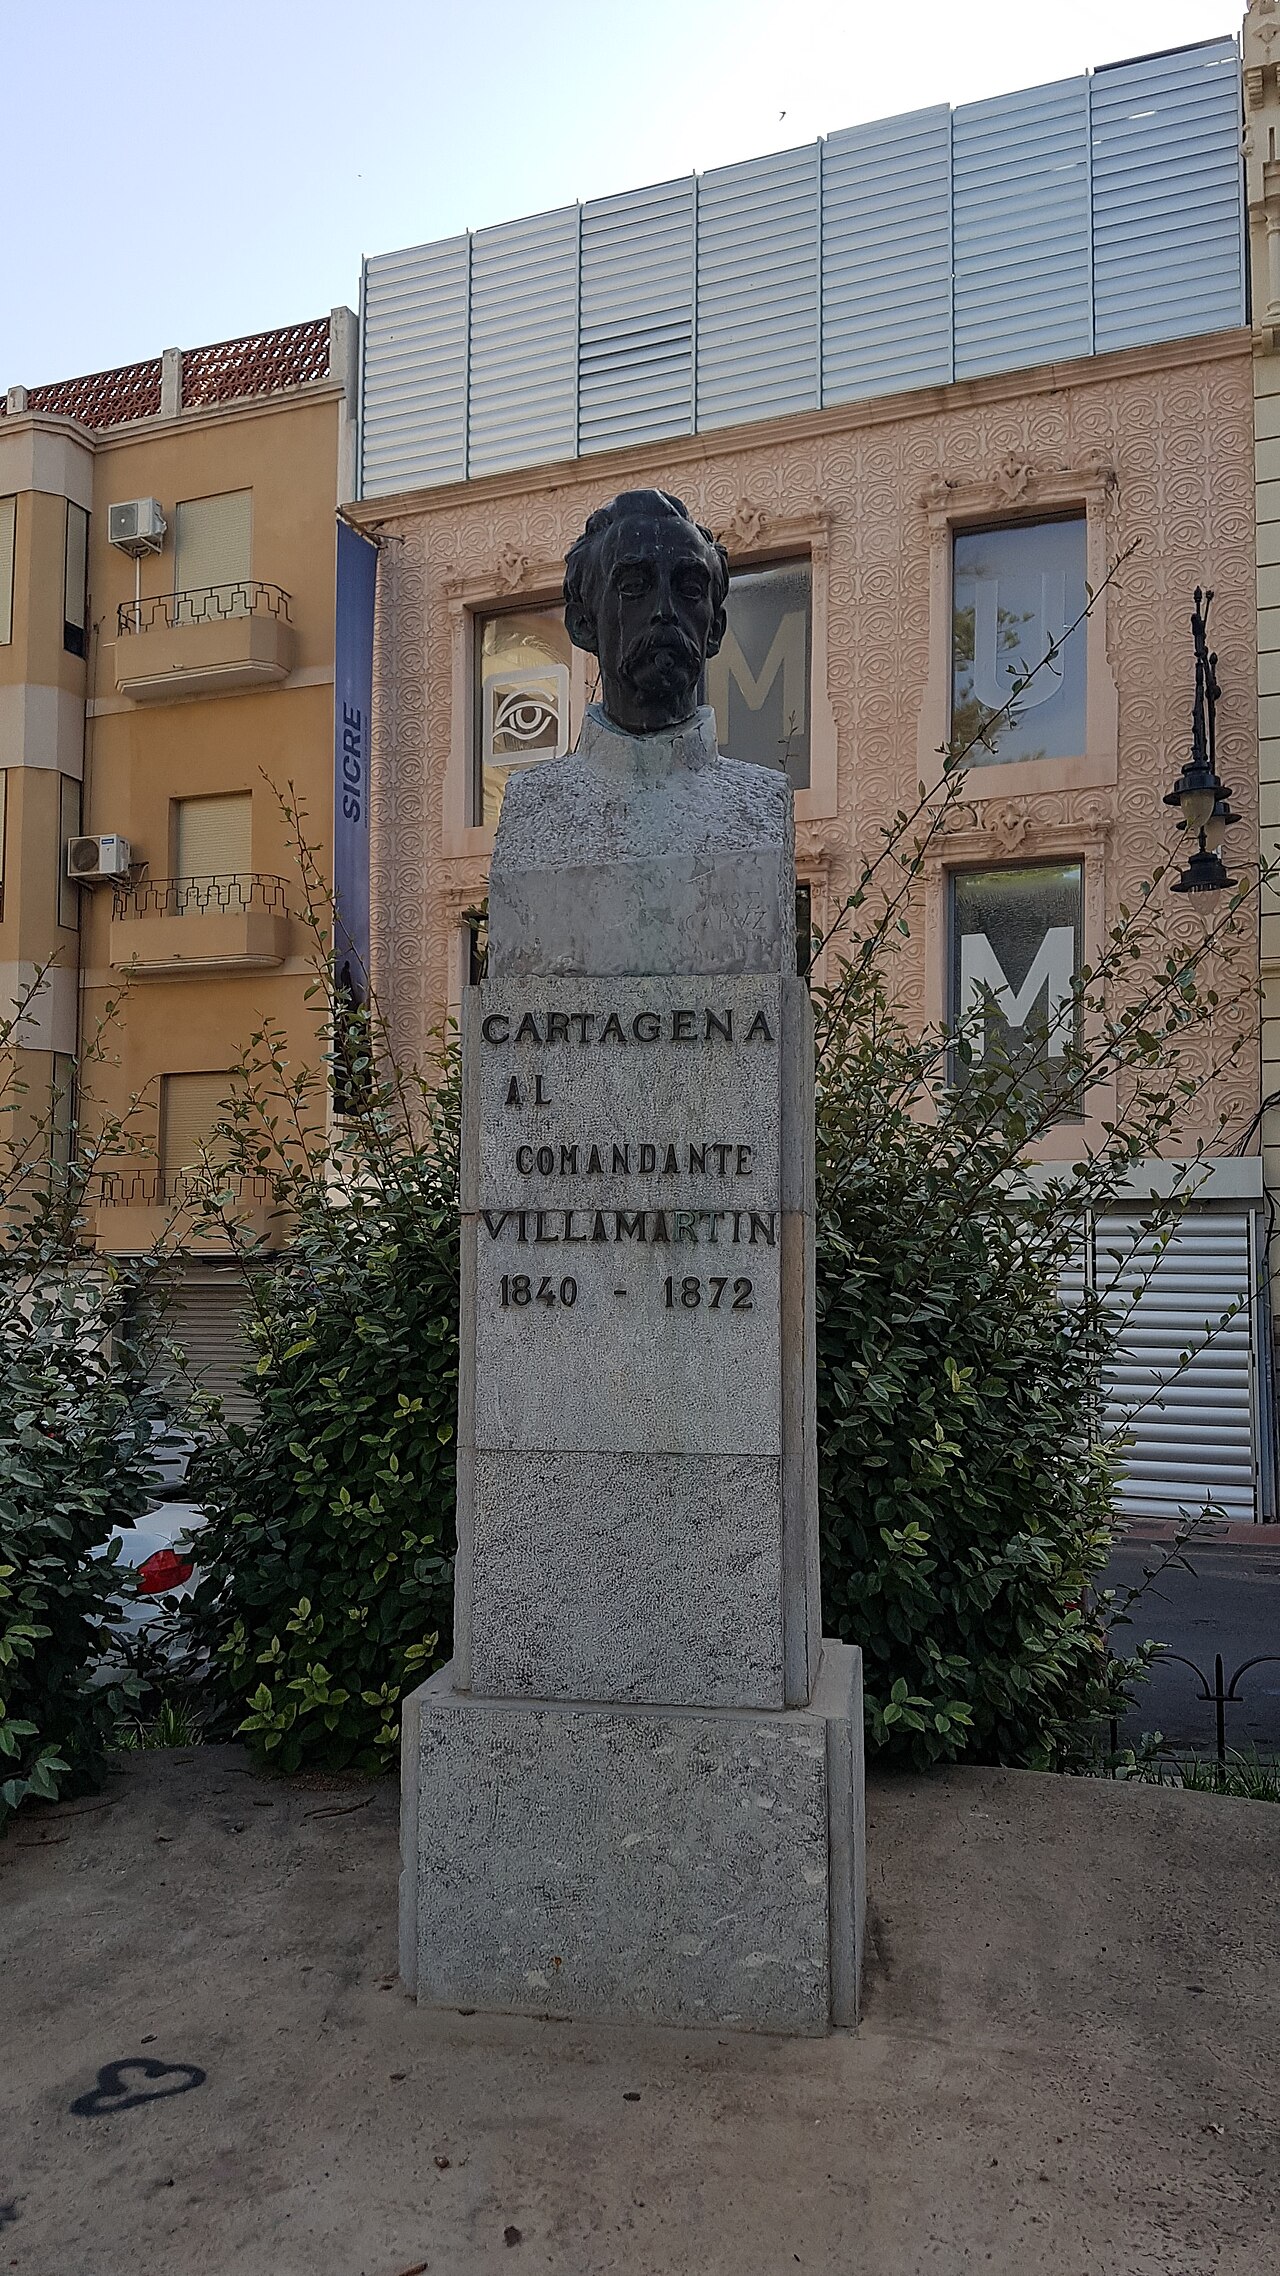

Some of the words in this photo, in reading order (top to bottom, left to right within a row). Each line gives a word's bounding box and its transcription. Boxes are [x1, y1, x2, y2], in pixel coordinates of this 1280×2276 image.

[342, 702, 361, 823] SICRE
[481, 1008, 775, 1044] CARTAGENA
[504, 1074, 552, 1105] AL
[515, 1141, 753, 1176] COMANDANTE
[480, 1210, 777, 1245] VILLAMARTIN
[499, 1274, 578, 1308] 1840
[664, 1276, 754, 1310] 1872
